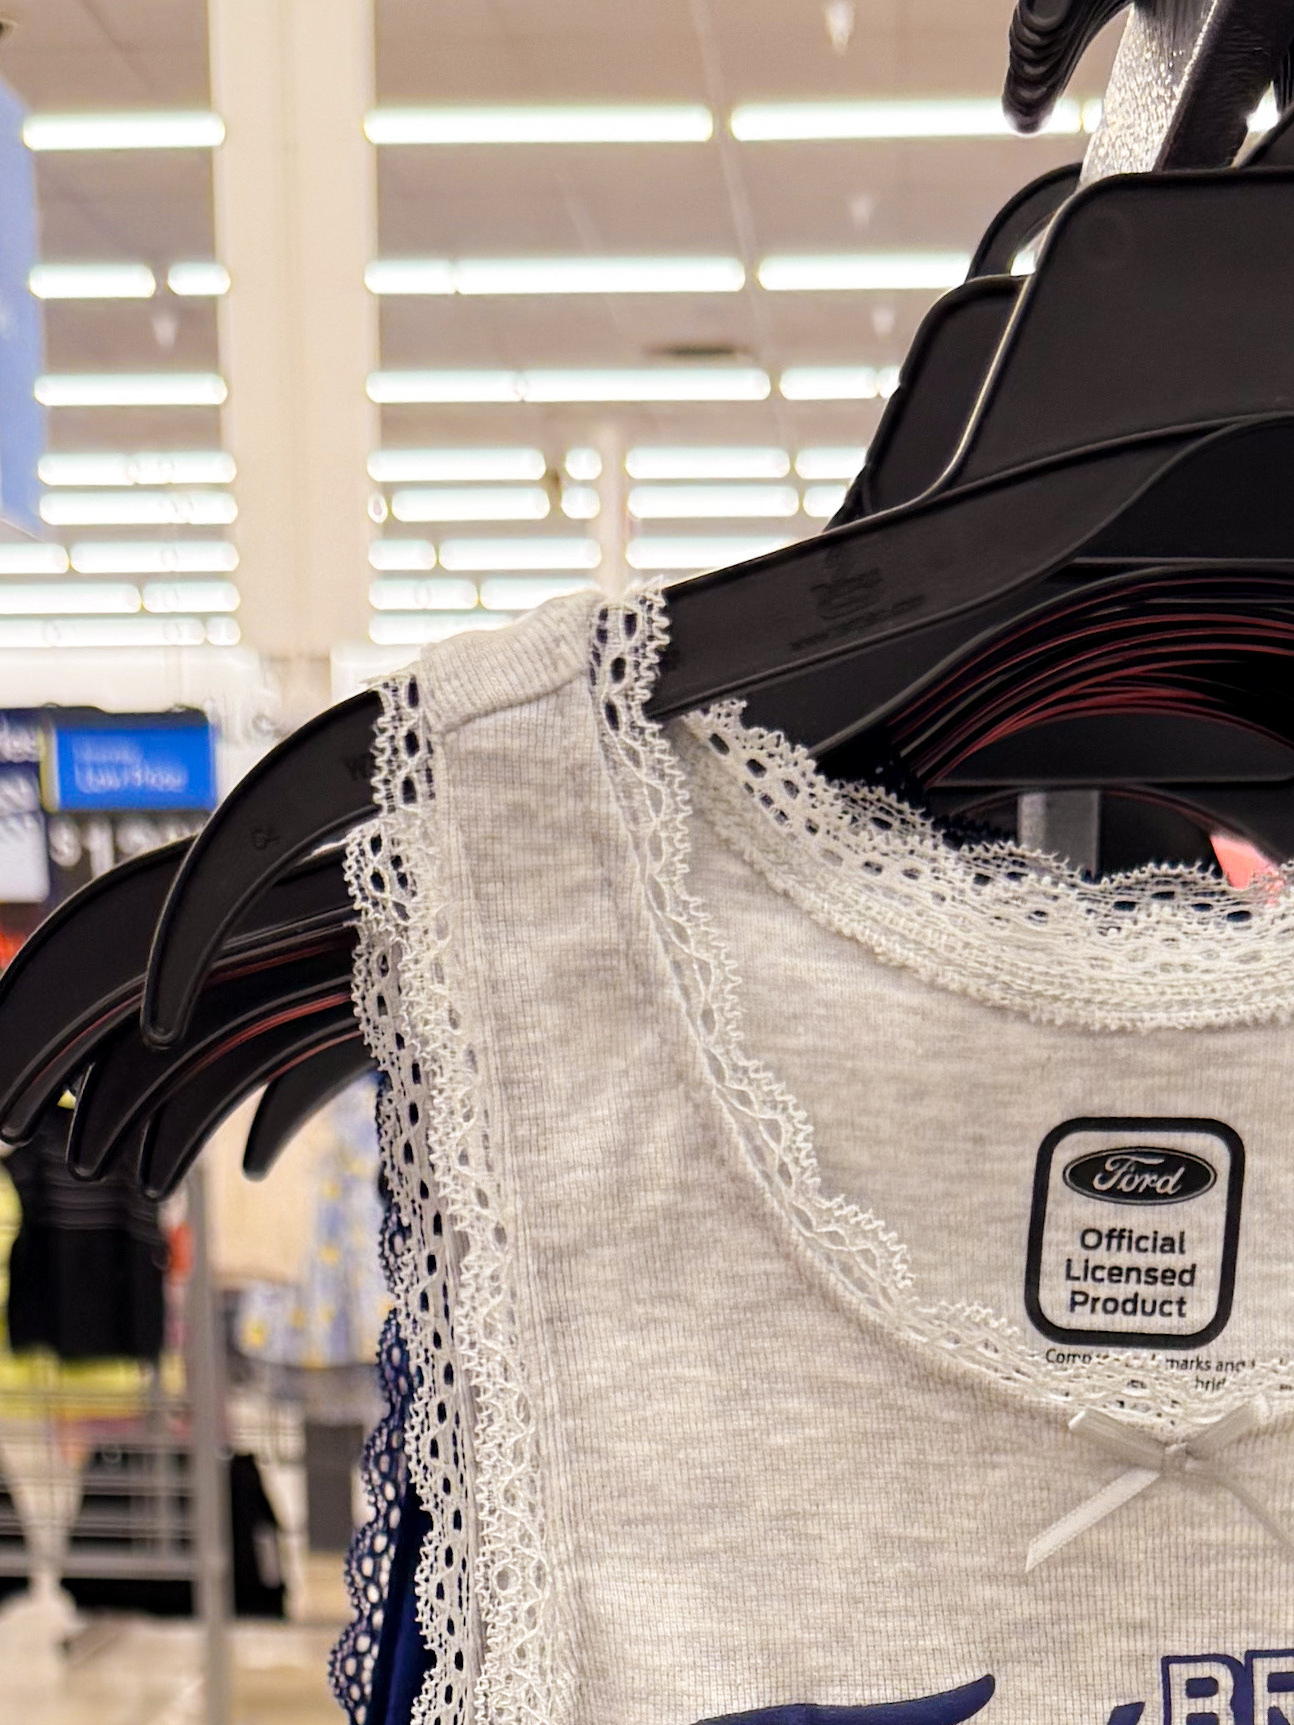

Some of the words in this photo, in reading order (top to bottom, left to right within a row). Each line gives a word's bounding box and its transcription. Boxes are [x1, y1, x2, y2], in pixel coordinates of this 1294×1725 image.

[1091, 1152, 1187, 1197] Ford
[1079, 1227, 1187, 1255] Official
[1064, 1258, 1197, 1287] Licensed
[1068, 1290, 1187, 1318] Product
